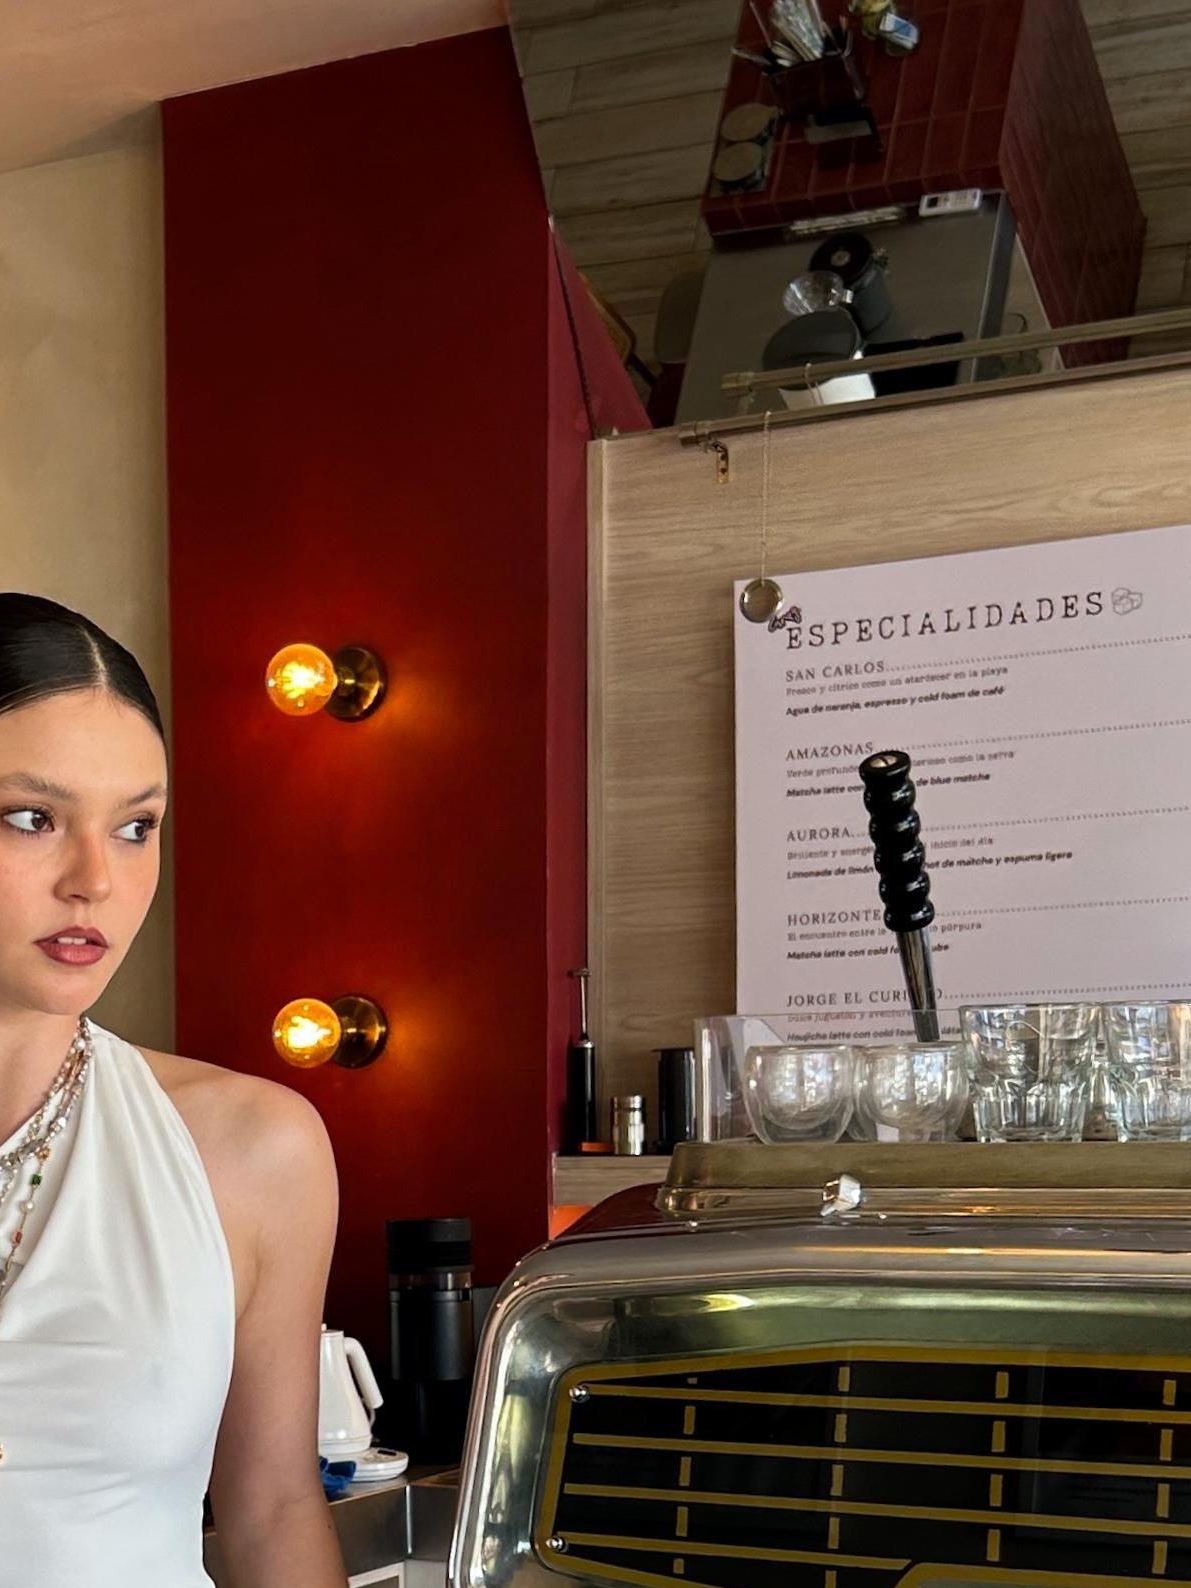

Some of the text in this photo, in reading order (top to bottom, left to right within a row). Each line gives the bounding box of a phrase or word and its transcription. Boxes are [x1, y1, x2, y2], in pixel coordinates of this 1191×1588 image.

[786, 591, 1104, 650] ESPECIALIDADES
[786, 661, 885, 682] SAN CARLOS
[819, 686, 826, 695] y
[861, 679, 887, 688] como
[890, 678, 903, 686] un
[953, 671, 966, 680] en
[969, 668, 978, 678] la
[981, 666, 1008, 678] playa
[786, 706, 810, 718] Agua
[811, 703, 824, 714] de
[864, 697, 908, 710] espresso
[909, 696, 916, 706] y
[918, 692, 940, 703] cold
[941, 690, 965, 701] foam
[967, 688, 980, 698] de
[982, 685, 1004, 697] café
[786, 742, 874, 761] AMAZONAS
[786, 786, 822, 798] Matcha
[823, 784, 845, 795] latte
[916, 777, 929, 787] de
[930, 776, 951, 785] blue
[953, 772, 991, 783] matcha
[787, 826, 851, 842] AURORA
[831, 850, 839, 858] y
[834, 866, 847, 876] de
[941, 857, 955, 868] de
[956, 855, 994, 867] matcha
[995, 855, 1002, 866] y
[1003, 852, 1044, 865] espuma
[1045, 850, 1073, 863] ligera
[849, 927, 876, 938] entre
[787, 950, 822, 961] Matcha
[824, 948, 847, 959] latte
[847, 946, 866, 958] con
[867, 944, 889, 957] cold
[787, 992, 838, 1008] JORGE
[844, 990, 864, 1005] EL
[829, 1030, 852, 1041] latte
[853, 1029, 871, 1040] con
